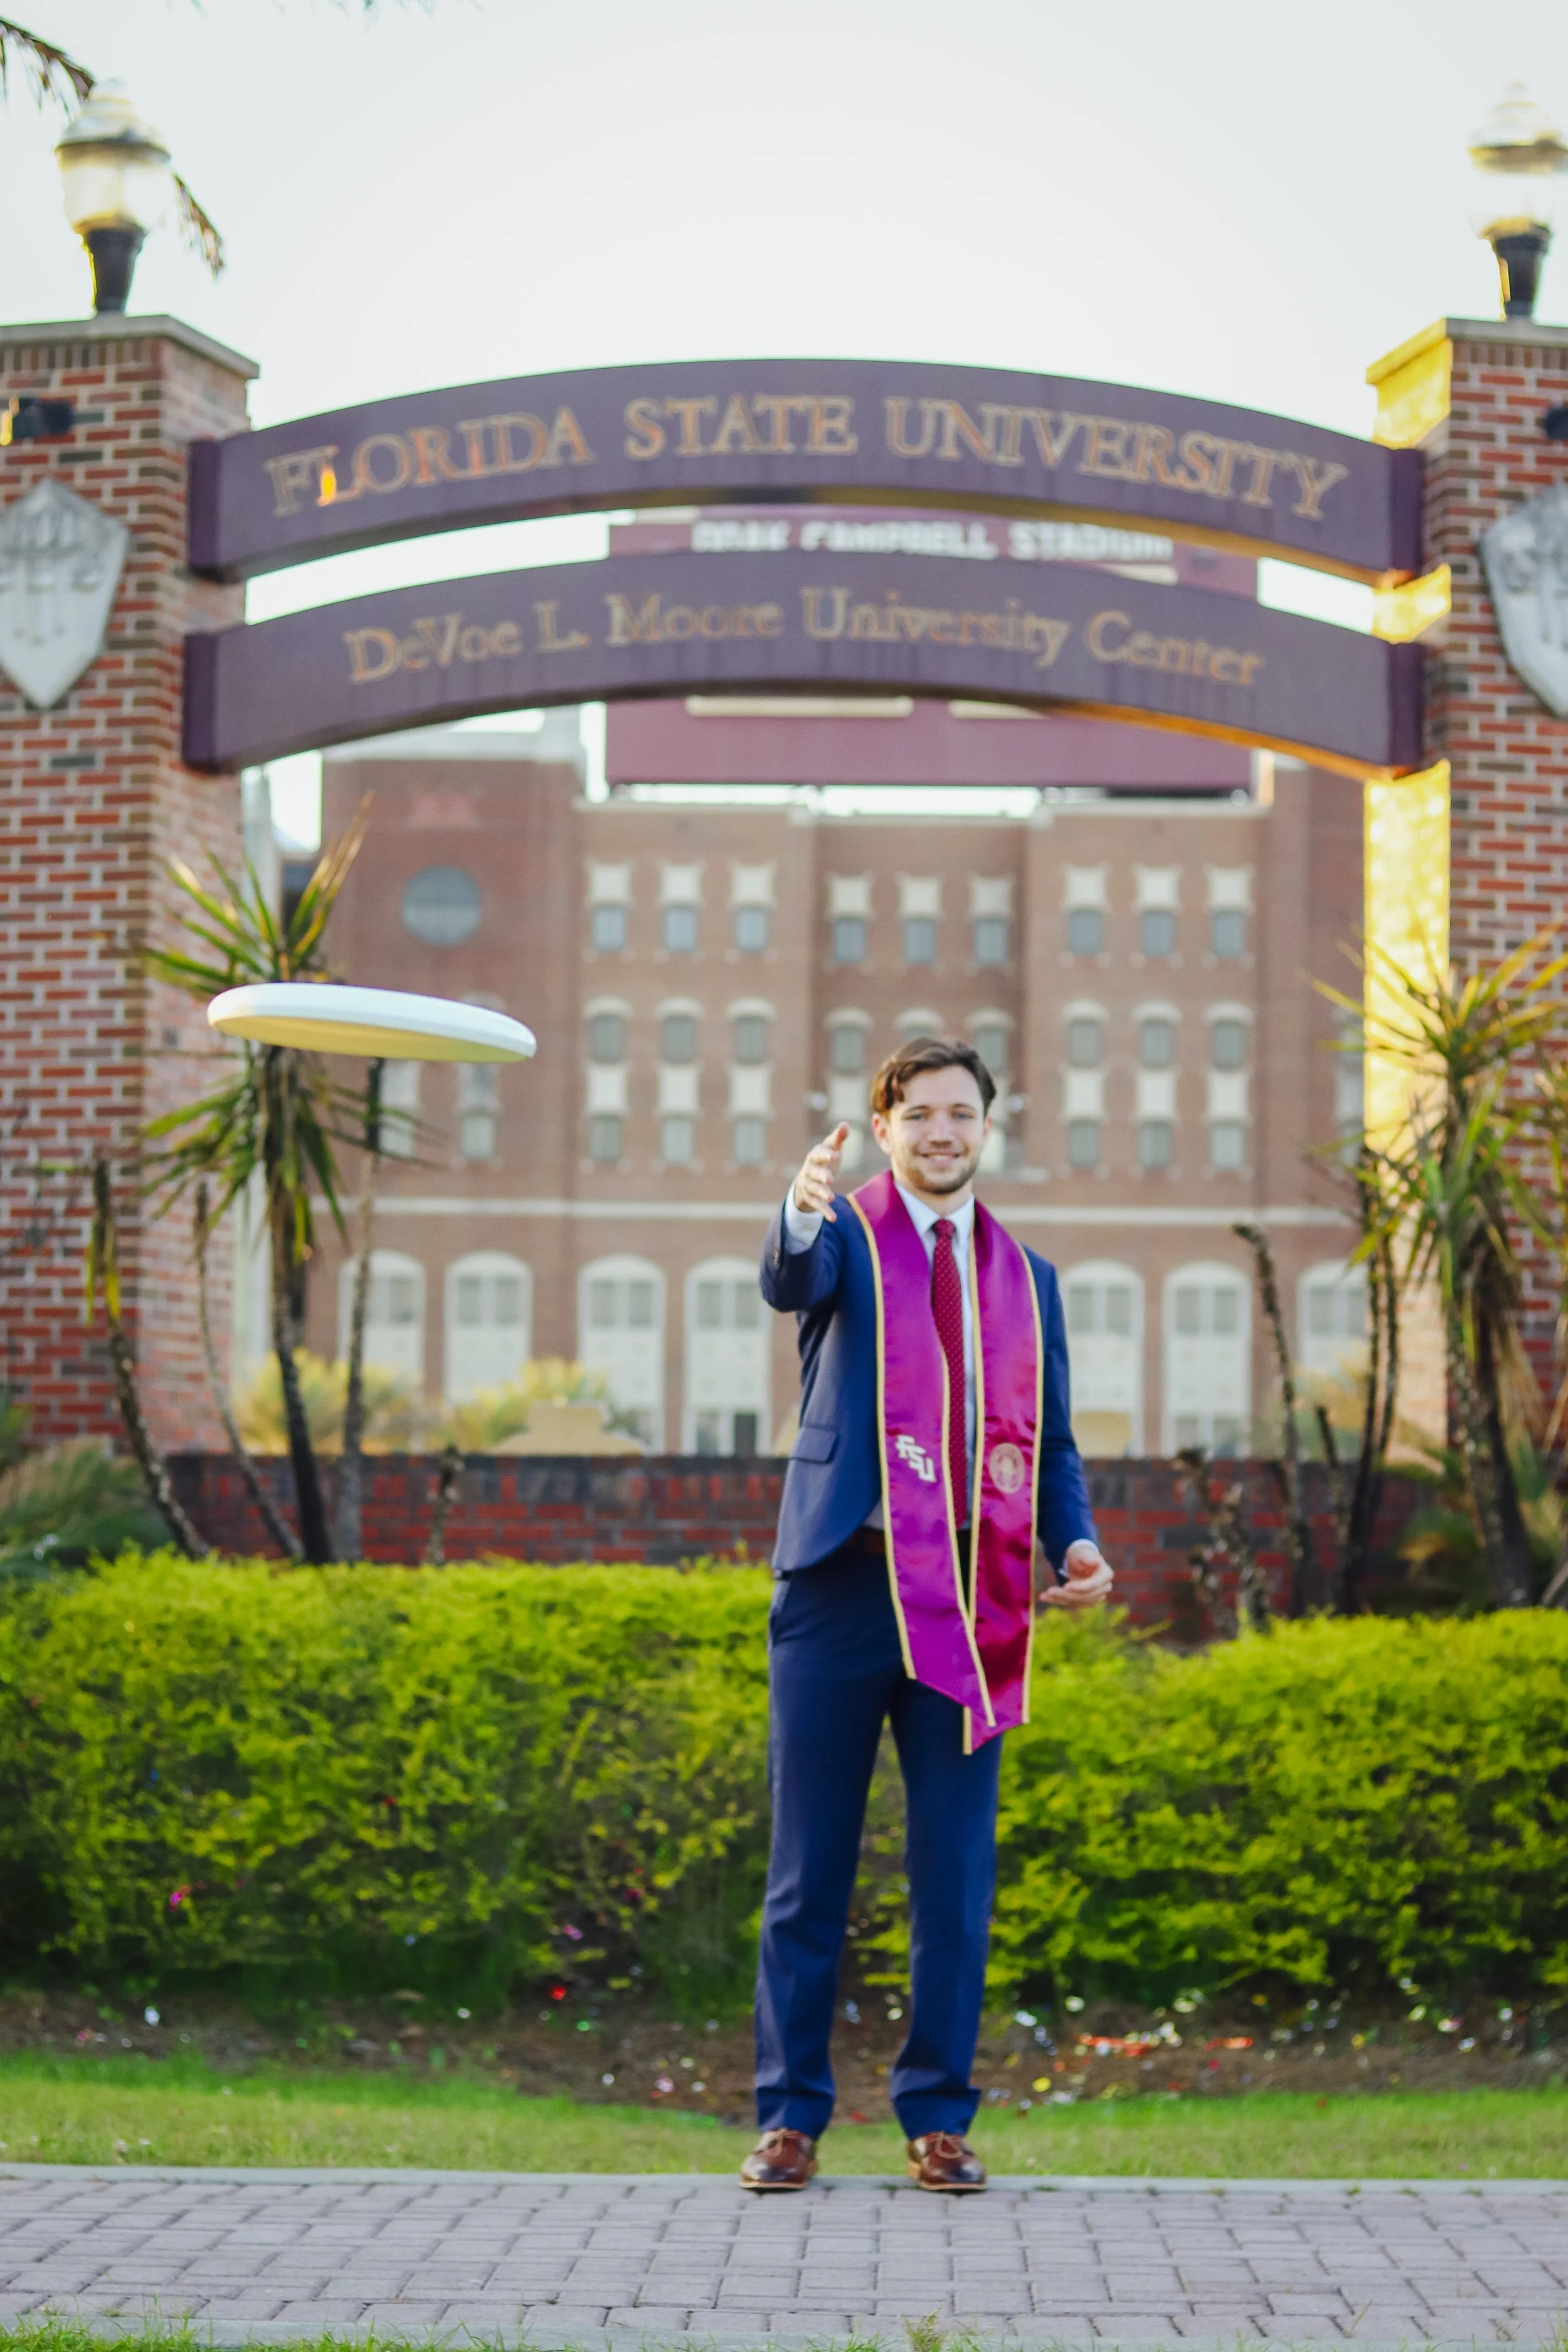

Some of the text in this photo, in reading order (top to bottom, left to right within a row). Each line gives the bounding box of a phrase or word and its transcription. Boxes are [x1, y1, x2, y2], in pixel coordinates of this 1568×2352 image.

[264, 392, 1349, 521] FLORIDA STATE UNIVERSITY
[1007, 519, 1173, 561] STADIUM
[344, 585, 1267, 686] DeVoe L. Moore University Center
[895, 1434, 937, 1483] FSU
